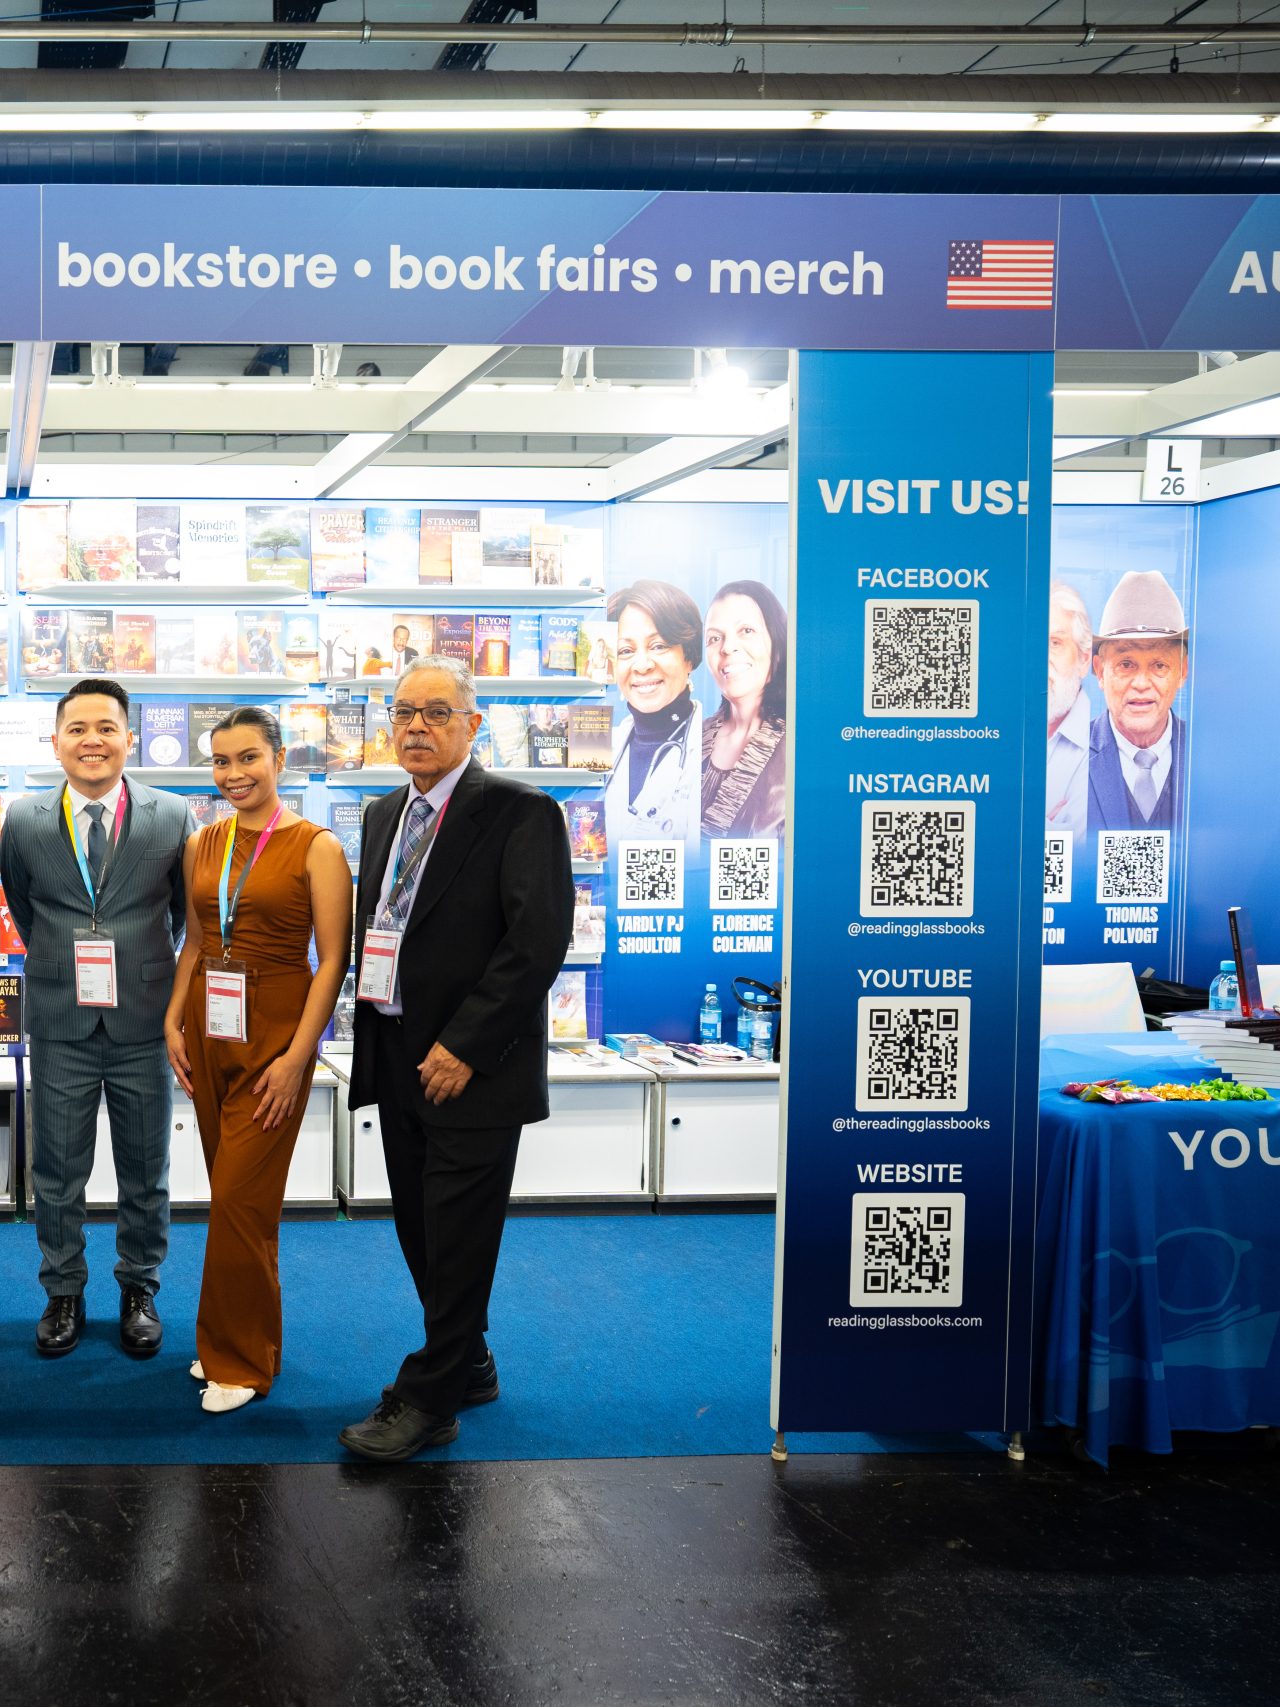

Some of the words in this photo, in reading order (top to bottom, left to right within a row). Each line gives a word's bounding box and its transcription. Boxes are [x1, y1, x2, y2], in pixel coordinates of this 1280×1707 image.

[58, 242, 338, 288] bookstore
[389, 244, 524, 291] book
[536, 243, 659, 293] fairs
[709, 250, 884, 296] merch
[1167, 445, 1183, 472] L
[1160, 477, 1185, 495] 26
[817, 479, 940, 514] VISIT
[951, 480, 1029, 515] US!
[188, 518, 238, 530] Spindrift
[320, 512, 365, 529] PRAYER
[426, 517, 477, 527] STRANGER
[188, 532, 239, 543] Memories
[857, 568, 989, 588] FACEBOOK
[333, 716, 358, 724] WHAT
[841, 726, 1000, 741] @thereadingglassbooks
[848, 774, 990, 793] INSTAGRAM
[712, 915, 774, 932] FLORENCE
[1105, 907, 1159, 924] THOMAS
[617, 916, 665, 933] YARDLY
[667, 916, 684, 932] PJ
[847, 922, 985, 937] @readingglassbooks
[1103, 927, 1159, 944] POLVOGT
[618, 936, 681, 954] SHOULTON
[712, 936, 773, 953] COLEMAN
[857, 969, 972, 988] YOUTUBE
[832, 1117, 990, 1132] @thereadingglassbooks
[857, 1164, 963, 1183] WEBSITE
[828, 1314, 983, 1329] readingglassbooks.com
